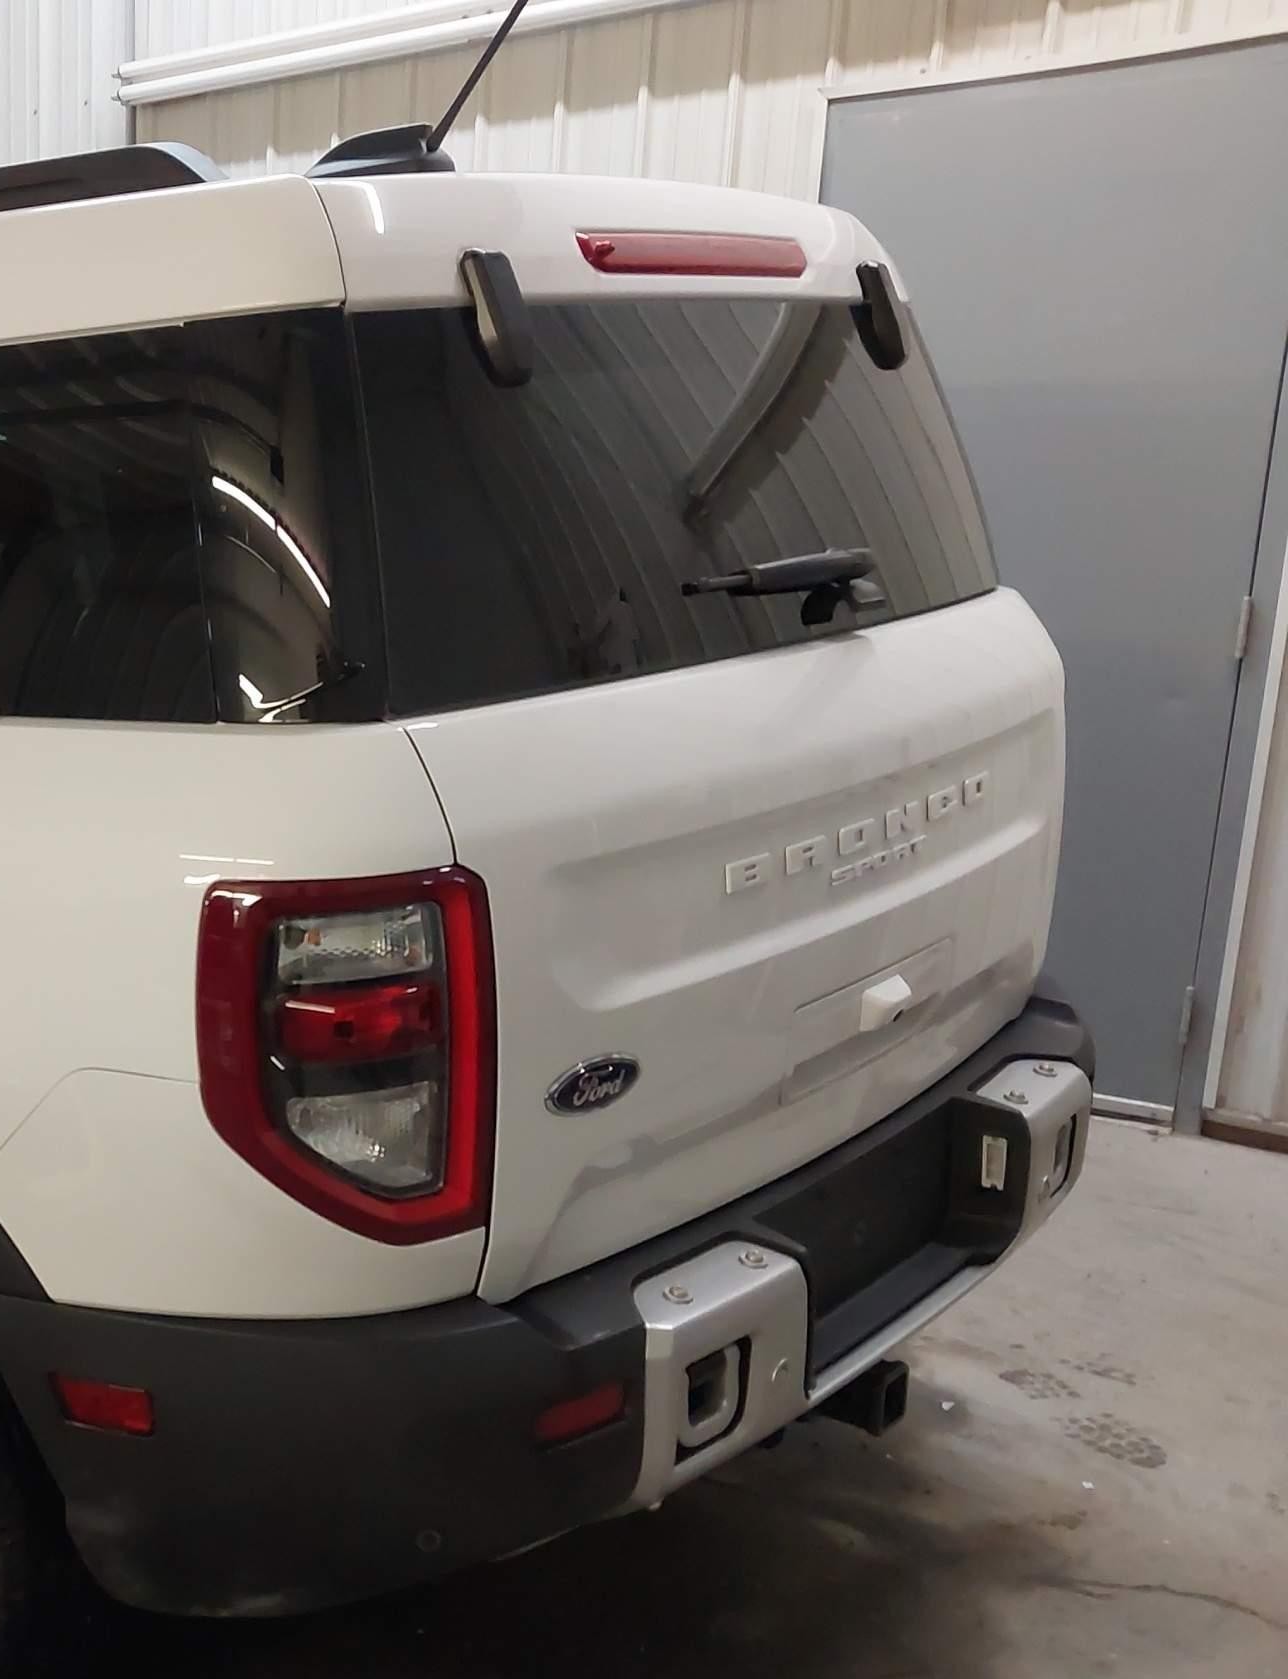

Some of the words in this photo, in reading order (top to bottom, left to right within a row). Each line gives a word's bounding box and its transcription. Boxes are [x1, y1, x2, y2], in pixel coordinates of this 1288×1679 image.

[726, 771, 989, 895] BRONCO
[831, 835, 927, 886] SPORT
[572, 1067, 625, 1106] Ford
